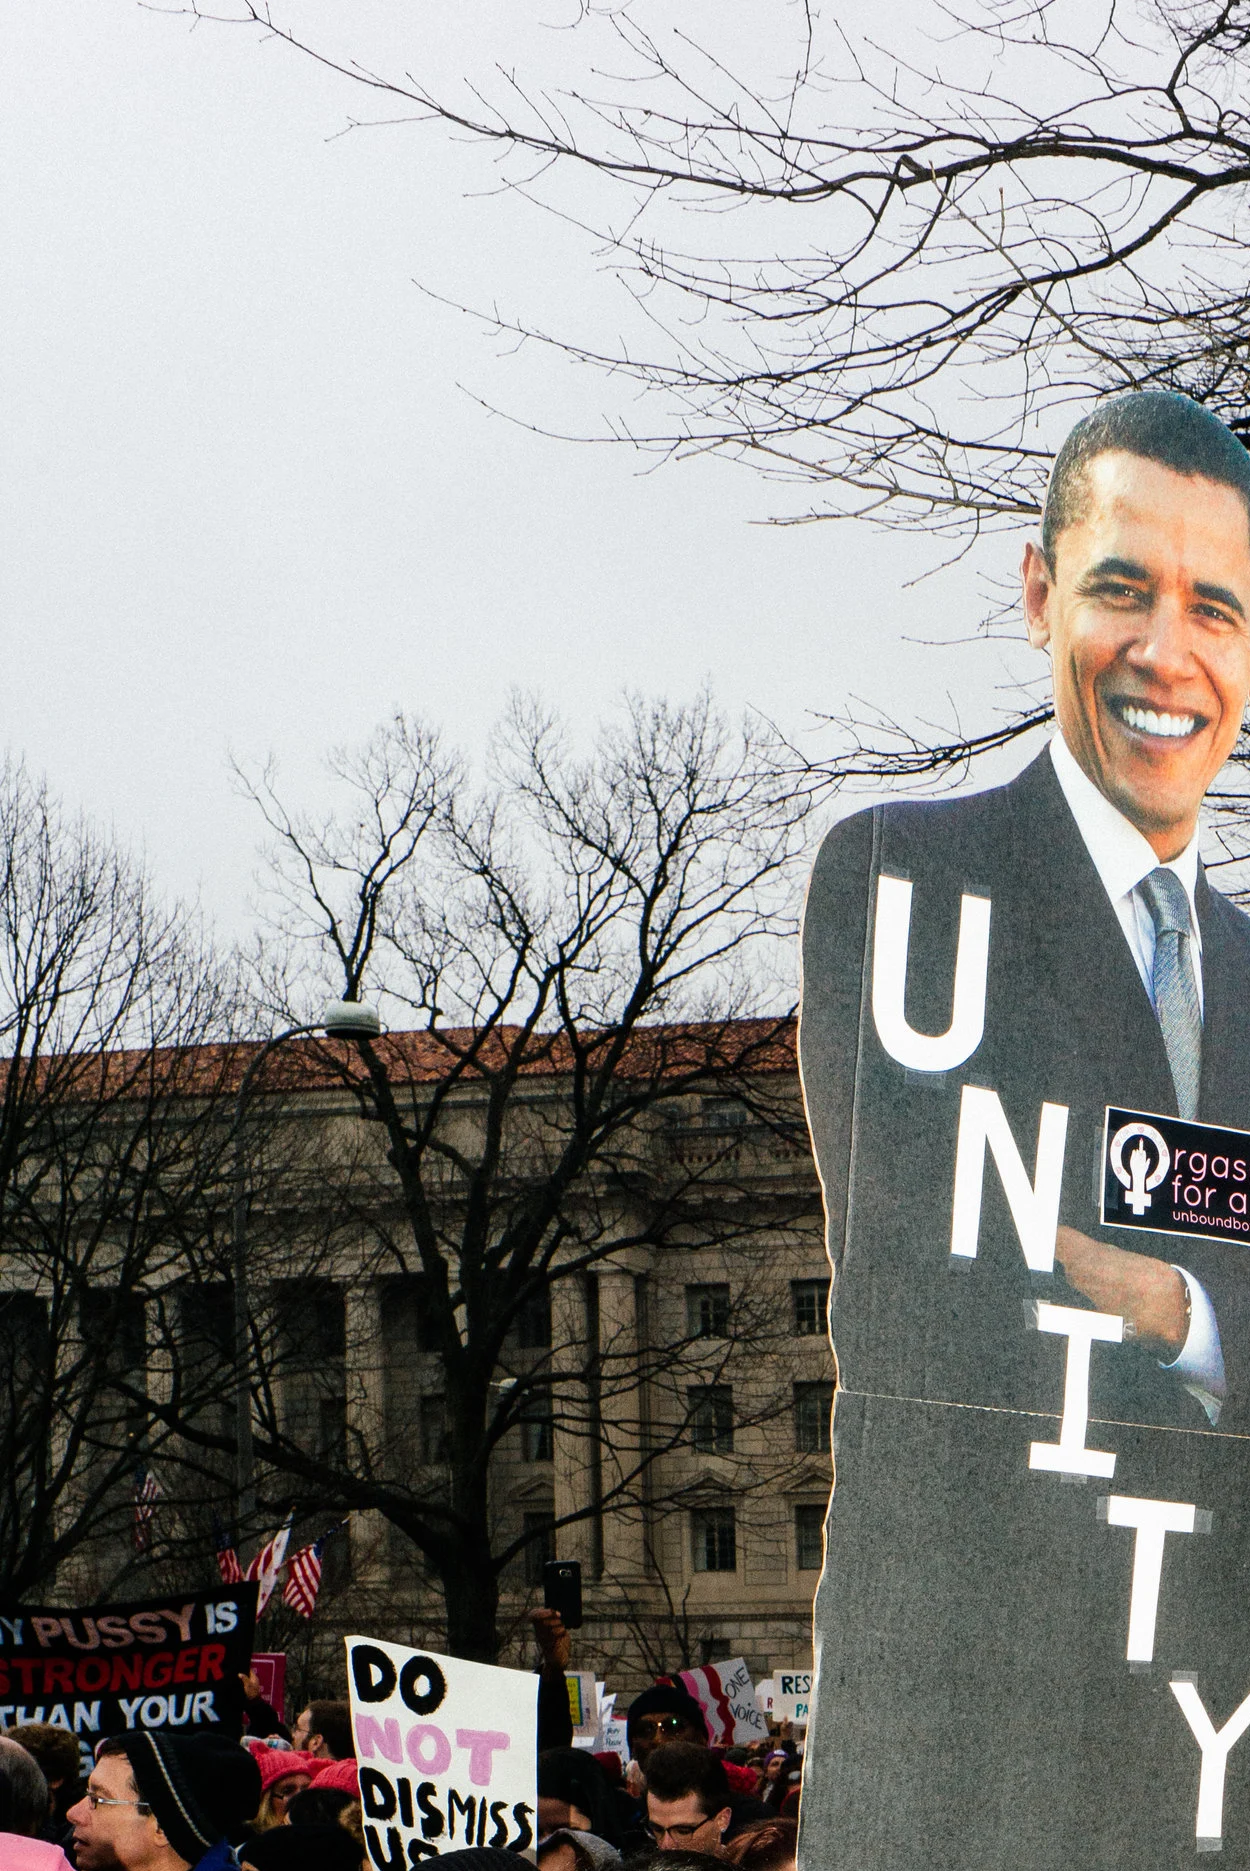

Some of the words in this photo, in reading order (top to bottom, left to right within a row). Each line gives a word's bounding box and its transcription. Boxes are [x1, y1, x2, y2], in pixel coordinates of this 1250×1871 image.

[1172, 1174, 1216, 1209] for
[31, 1603, 196, 1650] PUSSY
[205, 1601, 238, 1635] IS
[351, 1644, 448, 1716] DO
[725, 1666, 750, 1699] ONE
[117, 1690, 220, 1730] YOUR
[355, 1712, 511, 1787] NOT
[359, 1766, 535, 1851] DISMISS
